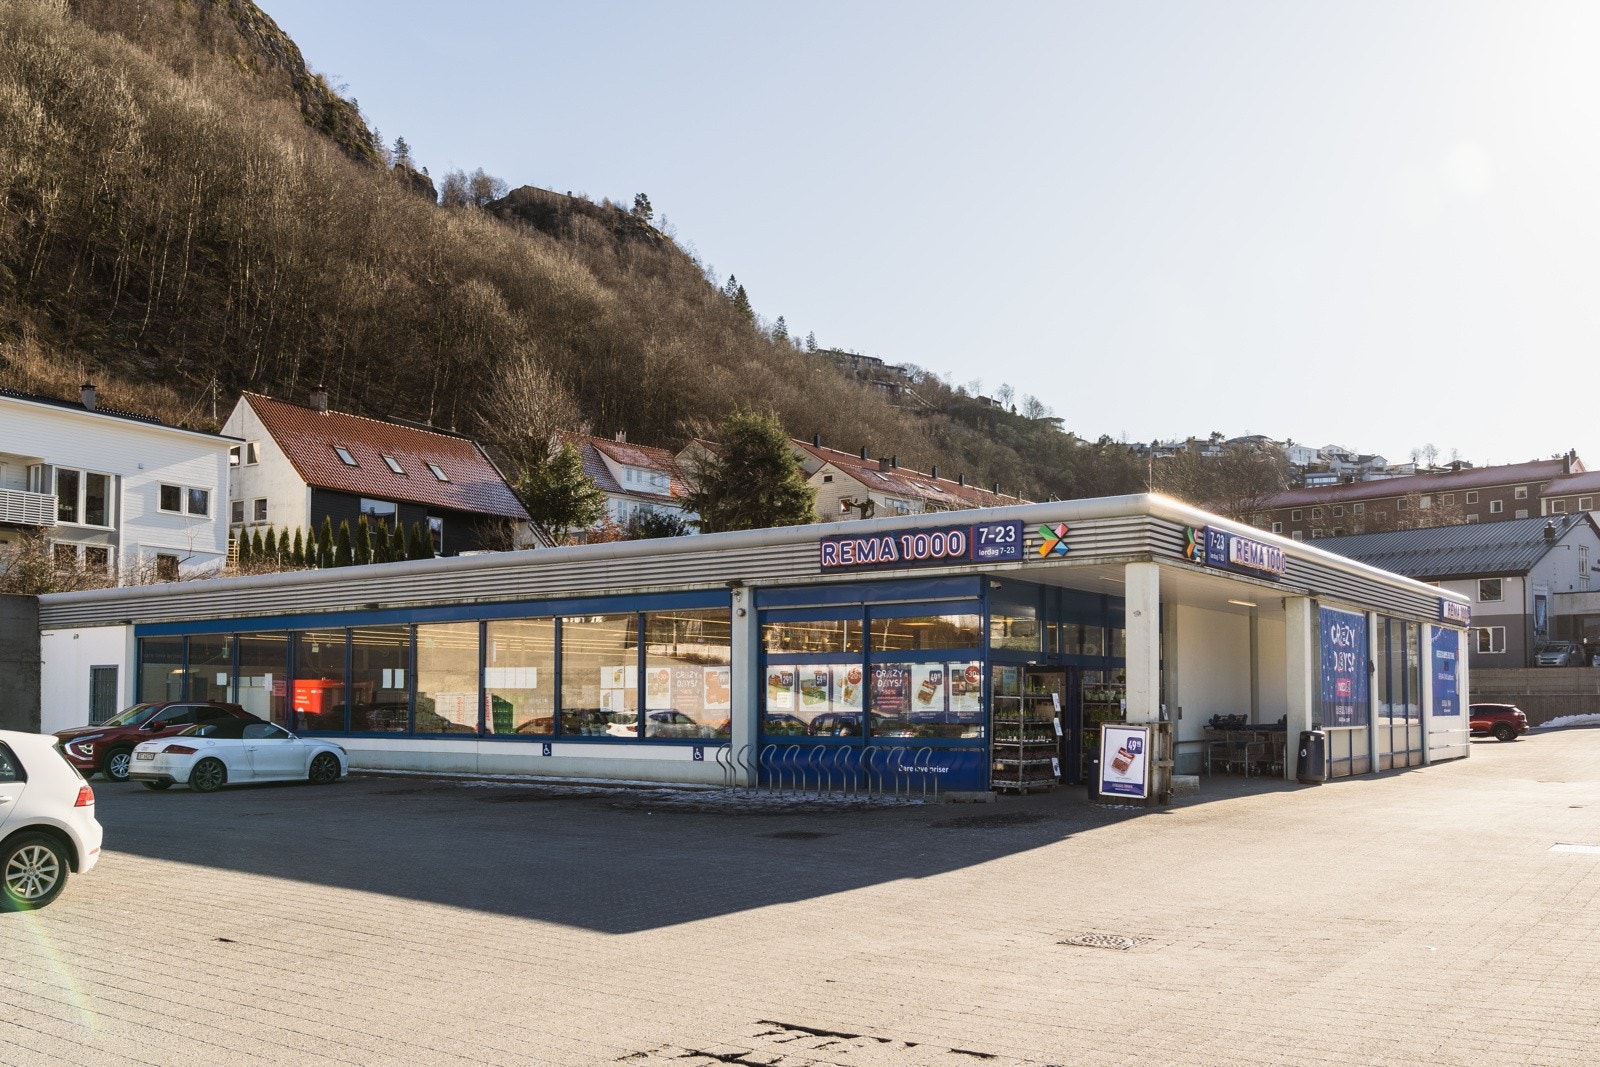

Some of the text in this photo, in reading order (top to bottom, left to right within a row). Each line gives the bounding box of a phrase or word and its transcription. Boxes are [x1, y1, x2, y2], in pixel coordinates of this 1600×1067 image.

[979, 525, 1016, 543] 7-23
[1210, 532, 1225, 550] 7-23
[821, 530, 966, 567] REMA 1000
[1000, 546, 1015, 554] 7-23
[1233, 537, 1286, 573] REMA 1000
[1128, 740, 1137, 750] 49
